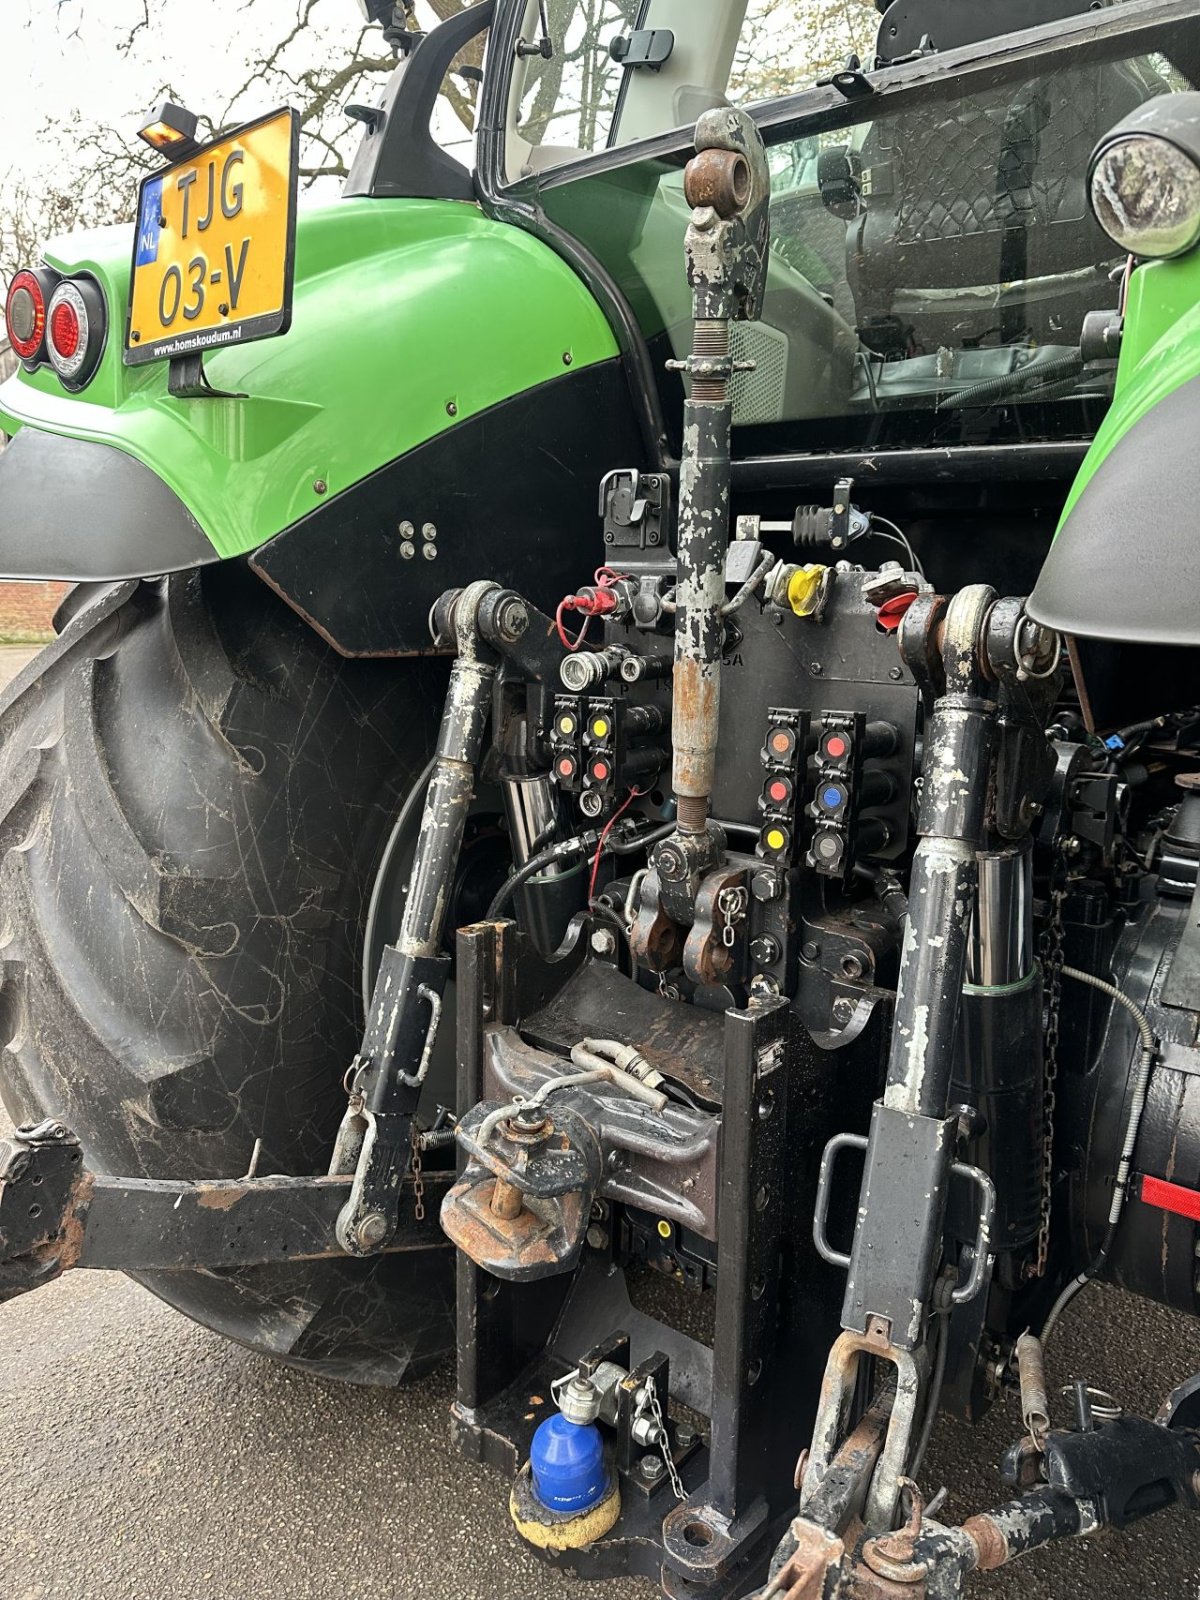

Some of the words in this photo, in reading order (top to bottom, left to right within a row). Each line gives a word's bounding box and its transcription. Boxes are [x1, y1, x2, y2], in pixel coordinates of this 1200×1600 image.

[178, 150, 244, 239] TJG
[141, 231, 155, 252] NL
[159, 237, 250, 327] 03-V
[153, 326, 242, 356] www.homskoudum.nl
